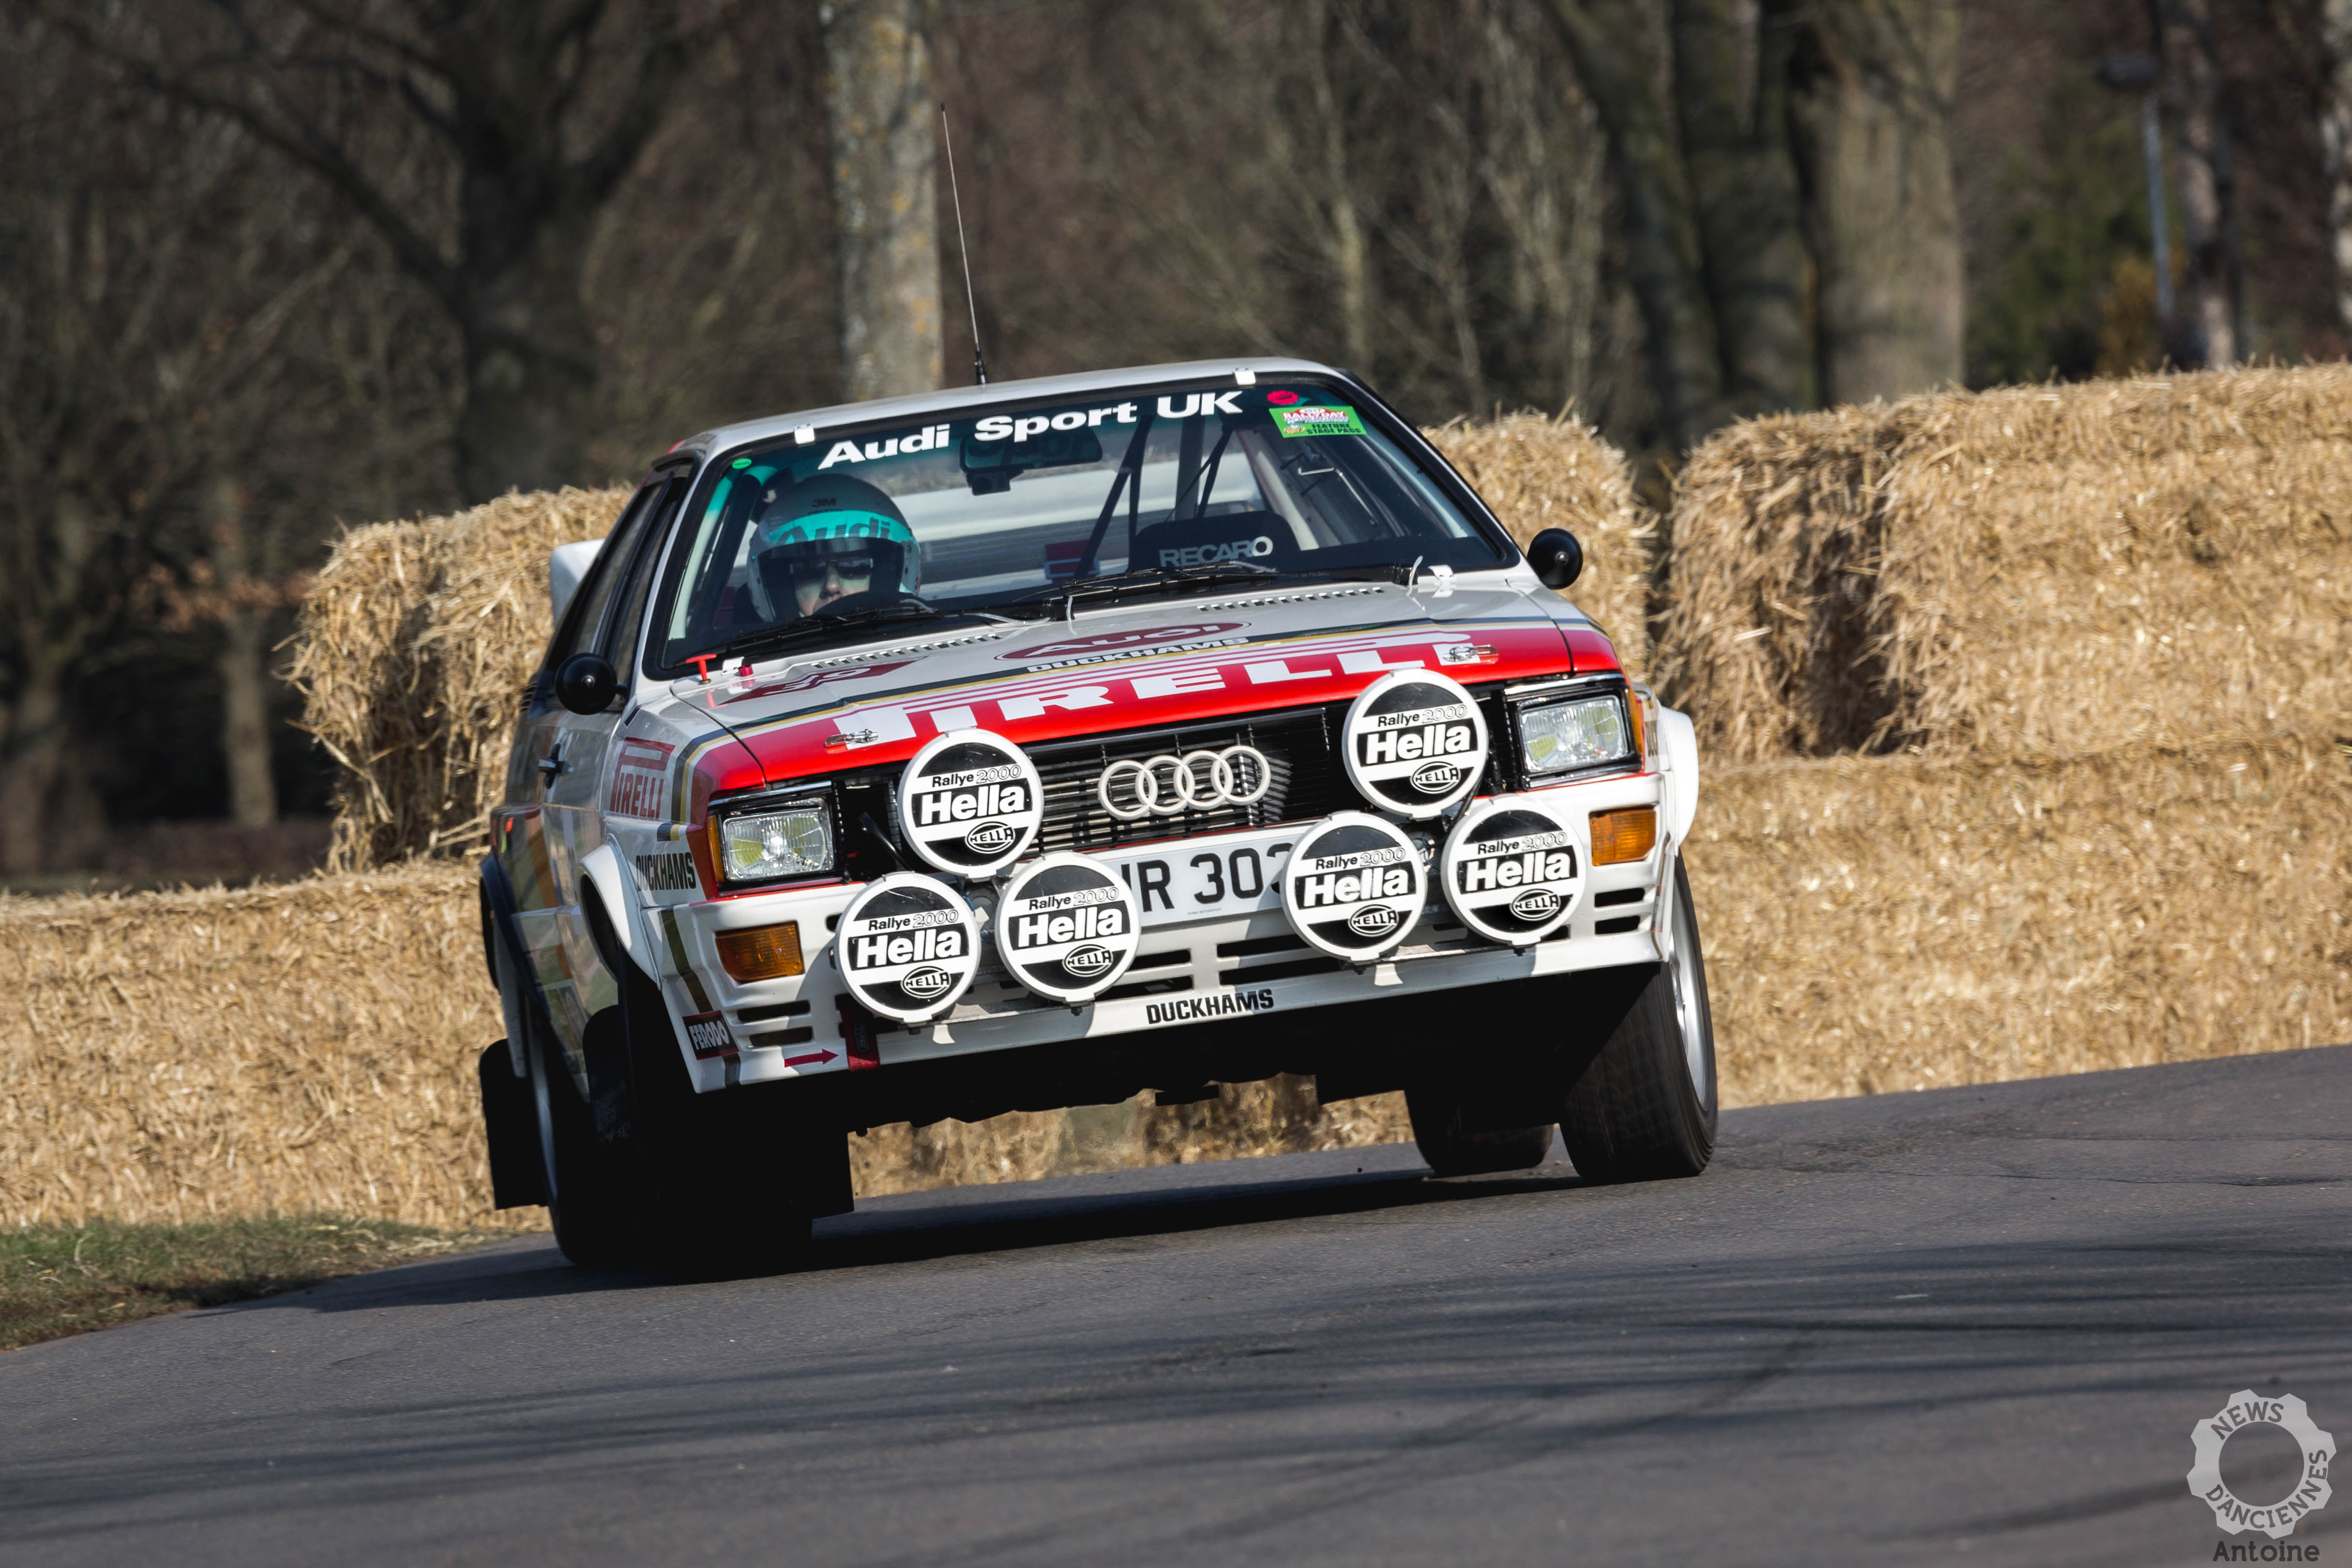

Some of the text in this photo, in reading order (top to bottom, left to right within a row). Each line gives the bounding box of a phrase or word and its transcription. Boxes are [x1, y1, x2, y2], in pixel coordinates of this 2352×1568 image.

[817, 391, 1243, 470] Audi Sport UK
[813, 498, 837, 508] 3M
[1159, 536, 1273, 567] RECARO
[1026, 637, 1250, 673] DUCKHAMS
[1378, 705, 1467, 727] Rallye 2000
[1366, 724, 1470, 764] Hella
[610, 737, 676, 820] PIRELLI
[932, 765, 1021, 787] Rallye 2000
[1416, 767, 1459, 783] HELLA
[921, 784, 1025, 825] Hella
[970, 827, 1014, 843] HELLA
[1478, 831, 1568, 855] Rallye 2000
[635, 852, 697, 892] DUCKHAMS
[1315, 847, 1405, 870] Rallye 2000
[1465, 851, 1570, 891] Hella
[1029, 887, 1119, 910] Rallye 2000
[1122, 859, 1175, 913] R
[1304, 867, 1409, 907] Hella
[1353, 910, 1397, 925] HELLA
[1515, 895, 1559, 910] HELLA
[868, 909, 959, 931] Rallye 2000
[1018, 906, 1122, 947] Hella
[857, 928, 961, 968] Hella
[1068, 950, 1112, 965] HELLA
[905, 971, 950, 987] HELLA
[1146, 988, 1274, 1025] DUCKHAMS
[689, 1020, 730, 1050] FERODO
